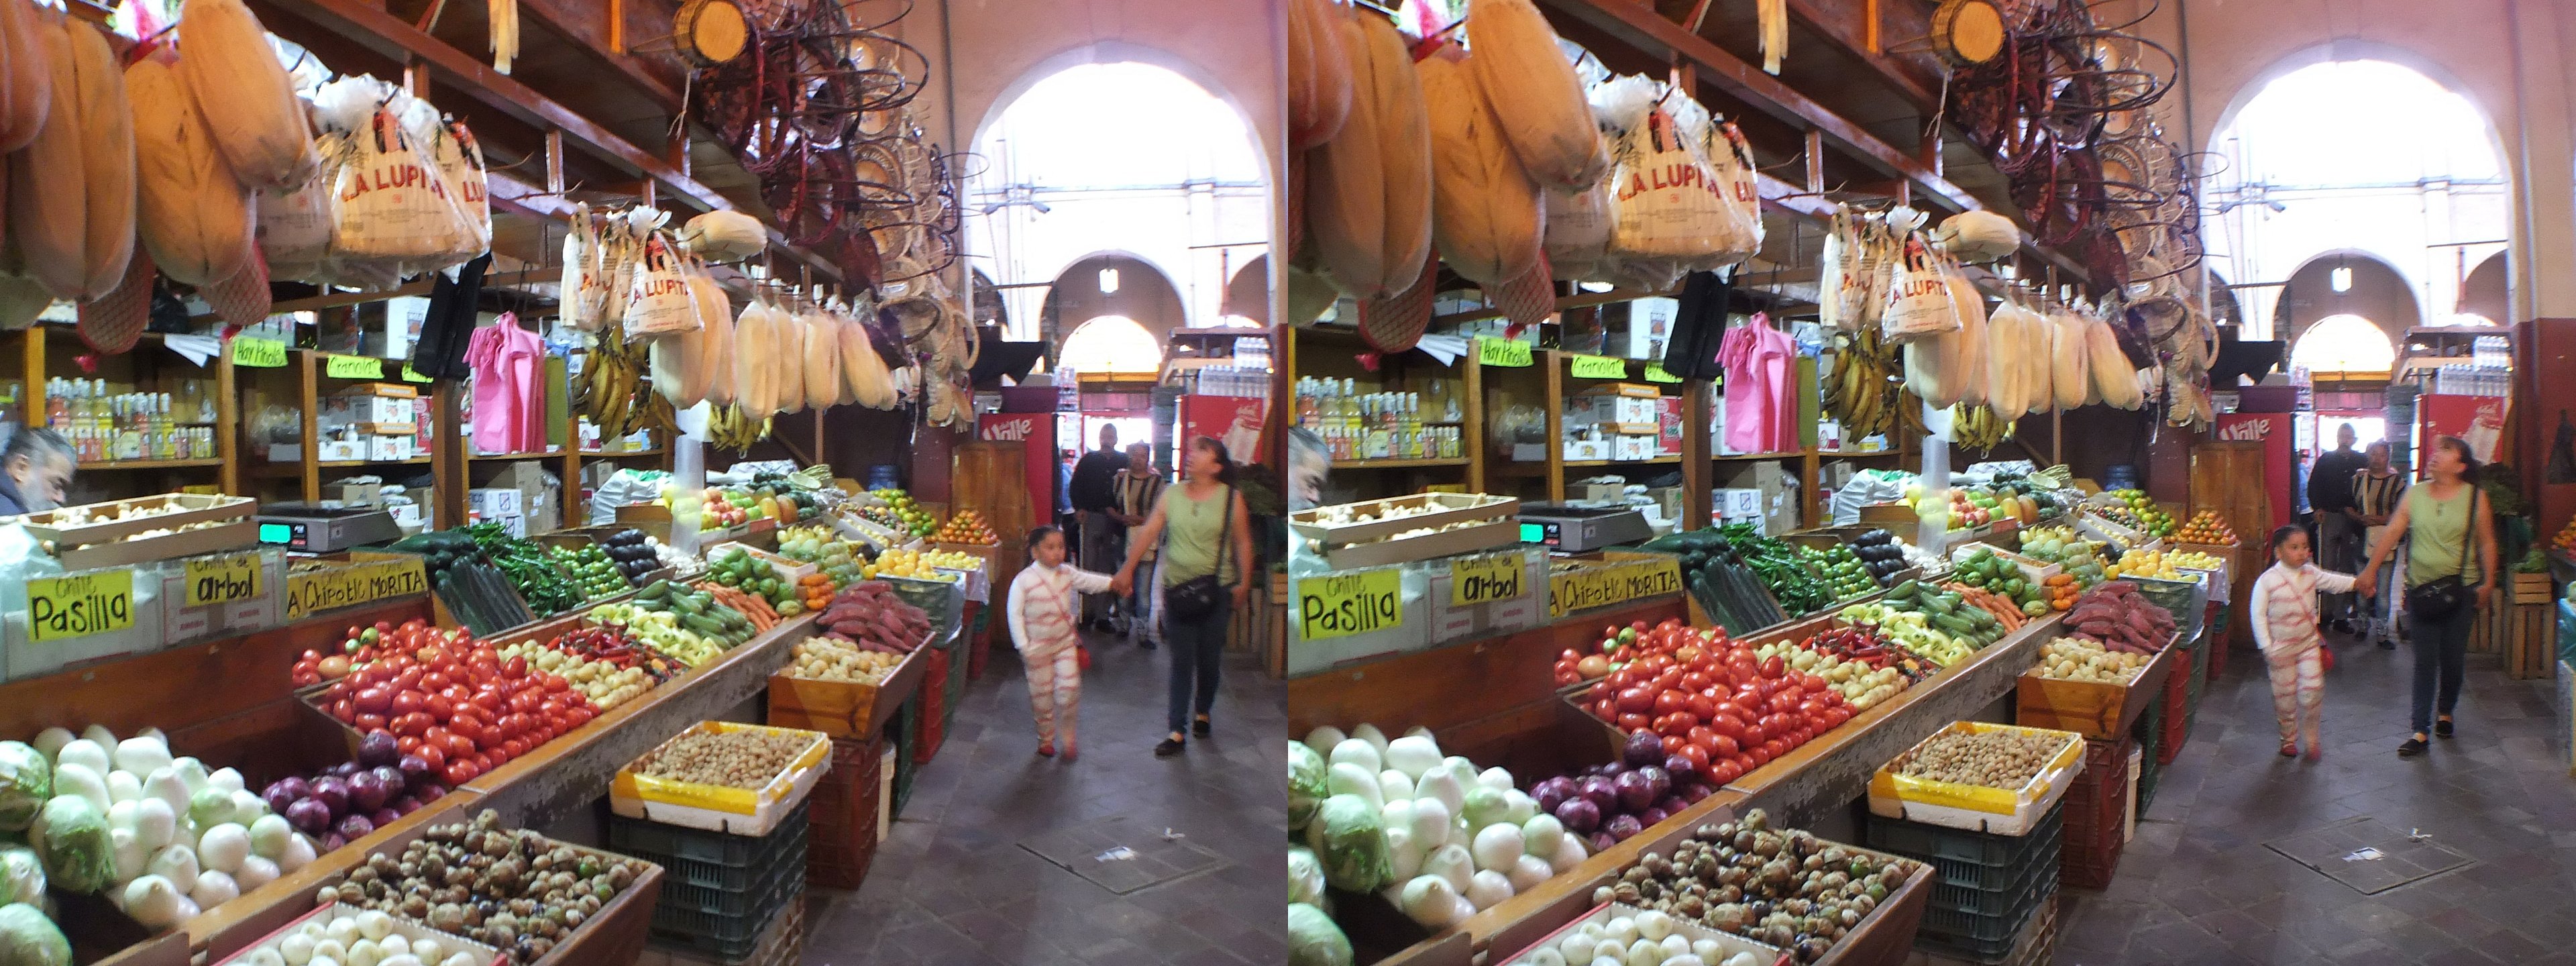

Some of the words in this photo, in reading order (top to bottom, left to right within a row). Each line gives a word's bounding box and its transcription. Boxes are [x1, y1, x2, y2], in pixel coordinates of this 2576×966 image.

[375, 164, 444, 200] LUPIA
[1652, 164, 1720, 199] LUPIA
[56, 575, 97, 599] Chile
[197, 570, 254, 602] arbol
[369, 570, 425, 600] MORITA
[1326, 575, 1366, 598] Chile
[1463, 569, 1518, 601] arbol
[1626, 569, 1680, 599] MORITA
[32, 592, 127, 639] Pasilla
[1303, 591, 1395, 639] Pasilla
